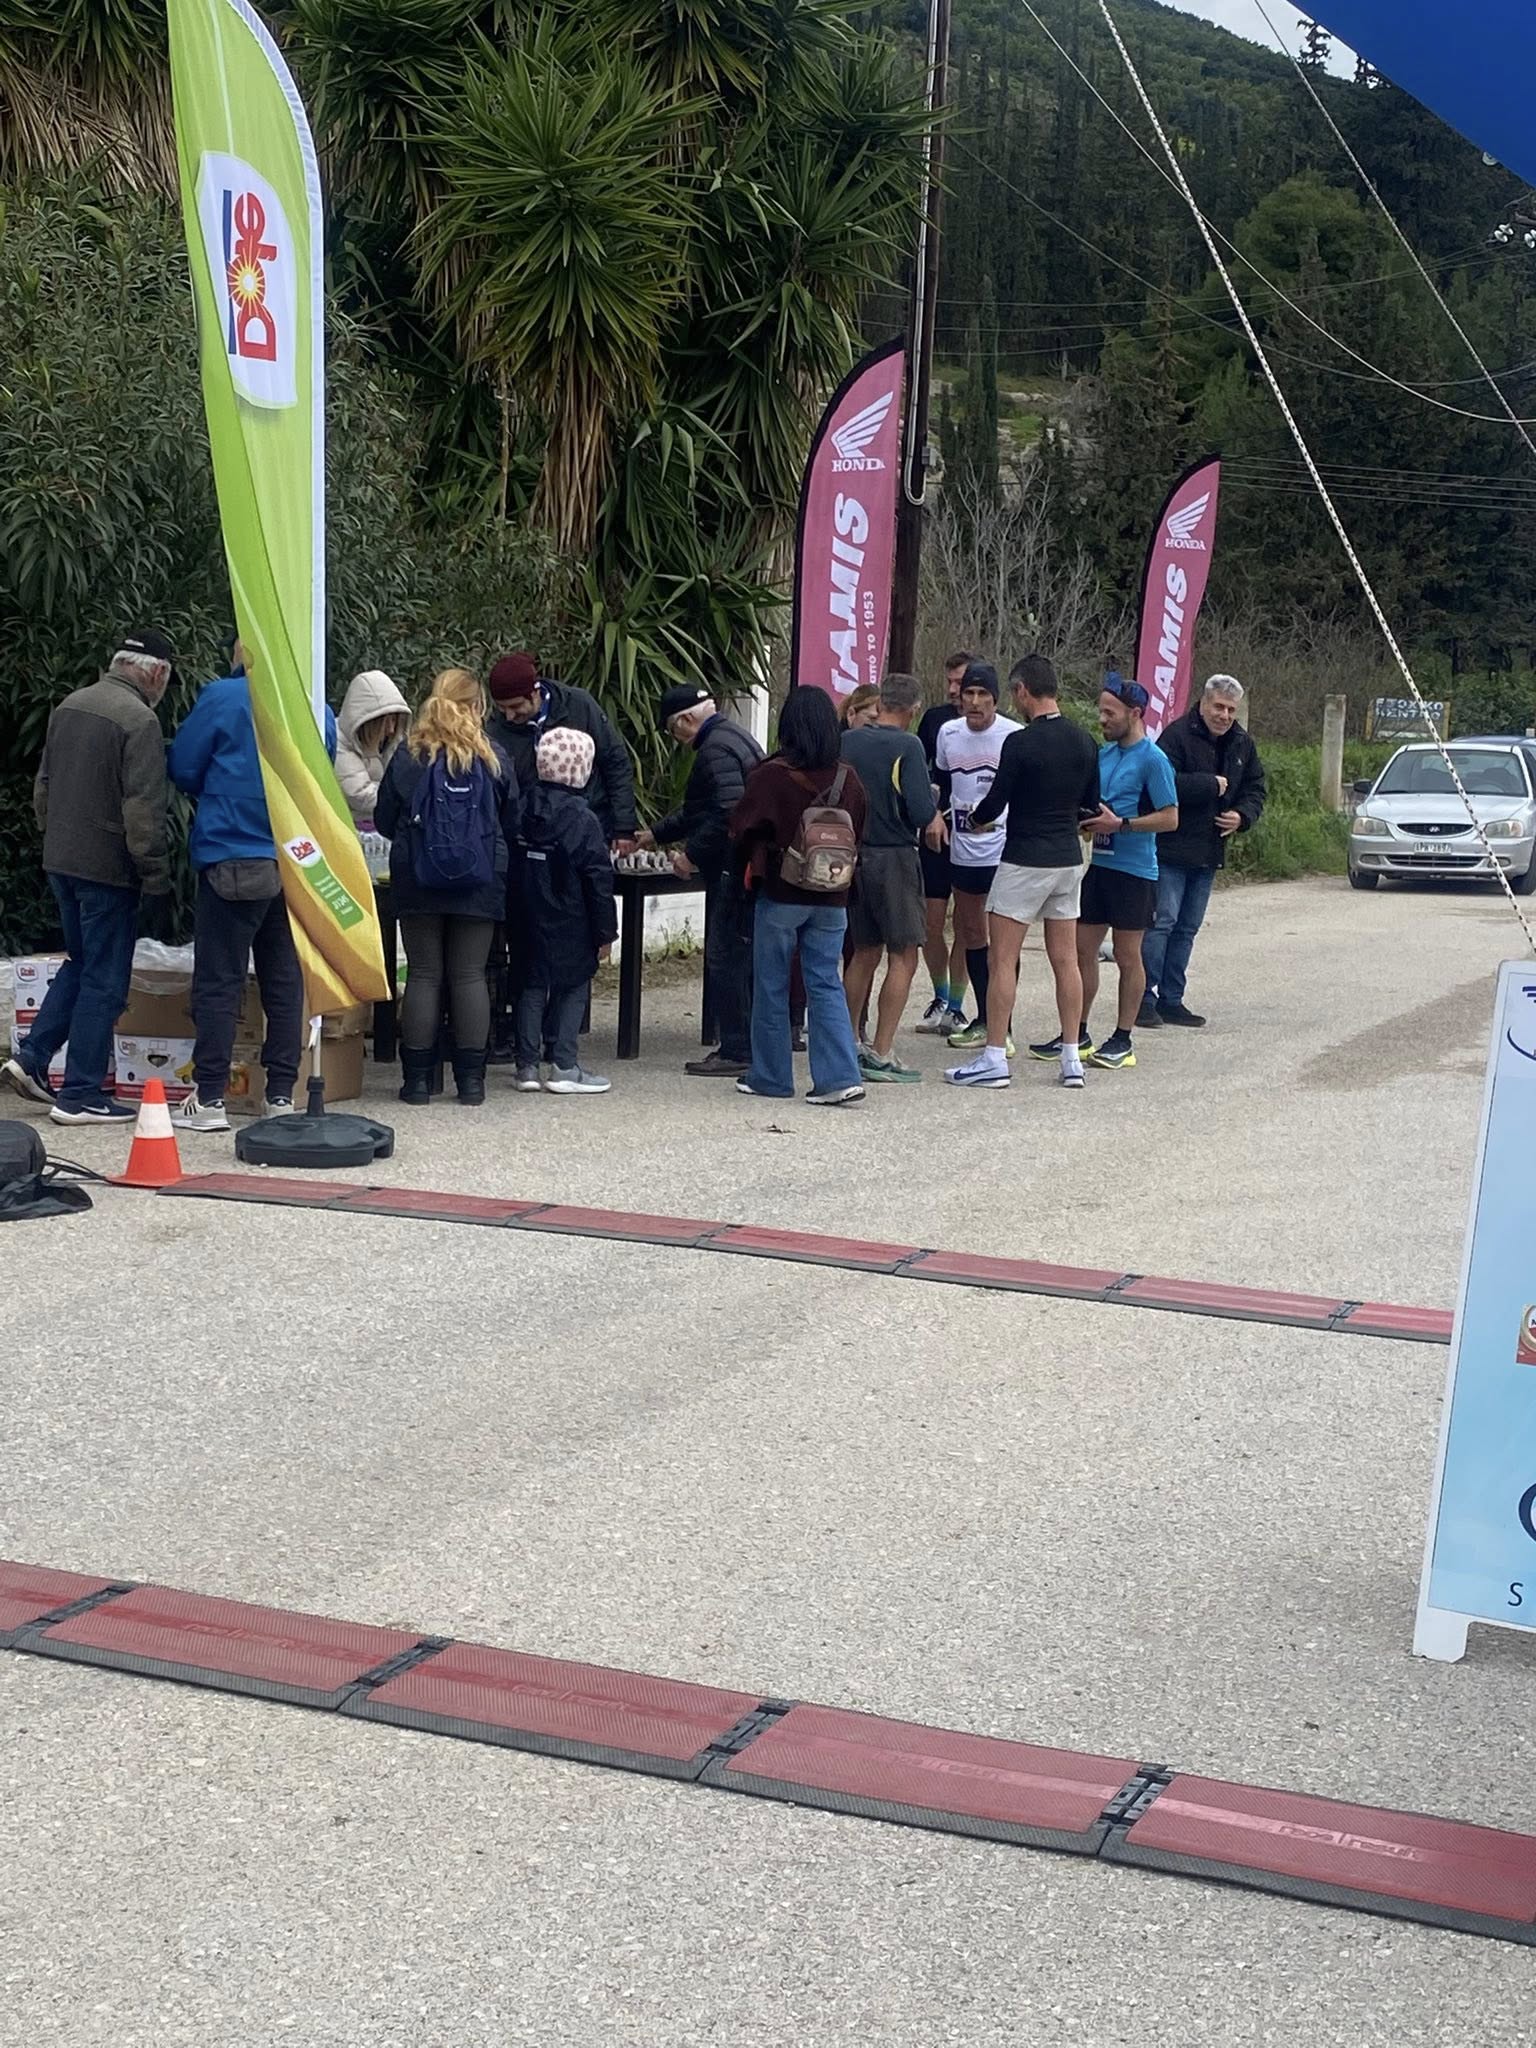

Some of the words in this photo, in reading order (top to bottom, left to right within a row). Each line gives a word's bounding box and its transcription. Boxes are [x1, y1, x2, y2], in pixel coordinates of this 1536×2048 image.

[227, 192, 277, 361] Dole
[1165, 538, 1206, 550] HONDA
[863, 591, 875, 629] 1953
[291, 841, 315, 858] Dole
